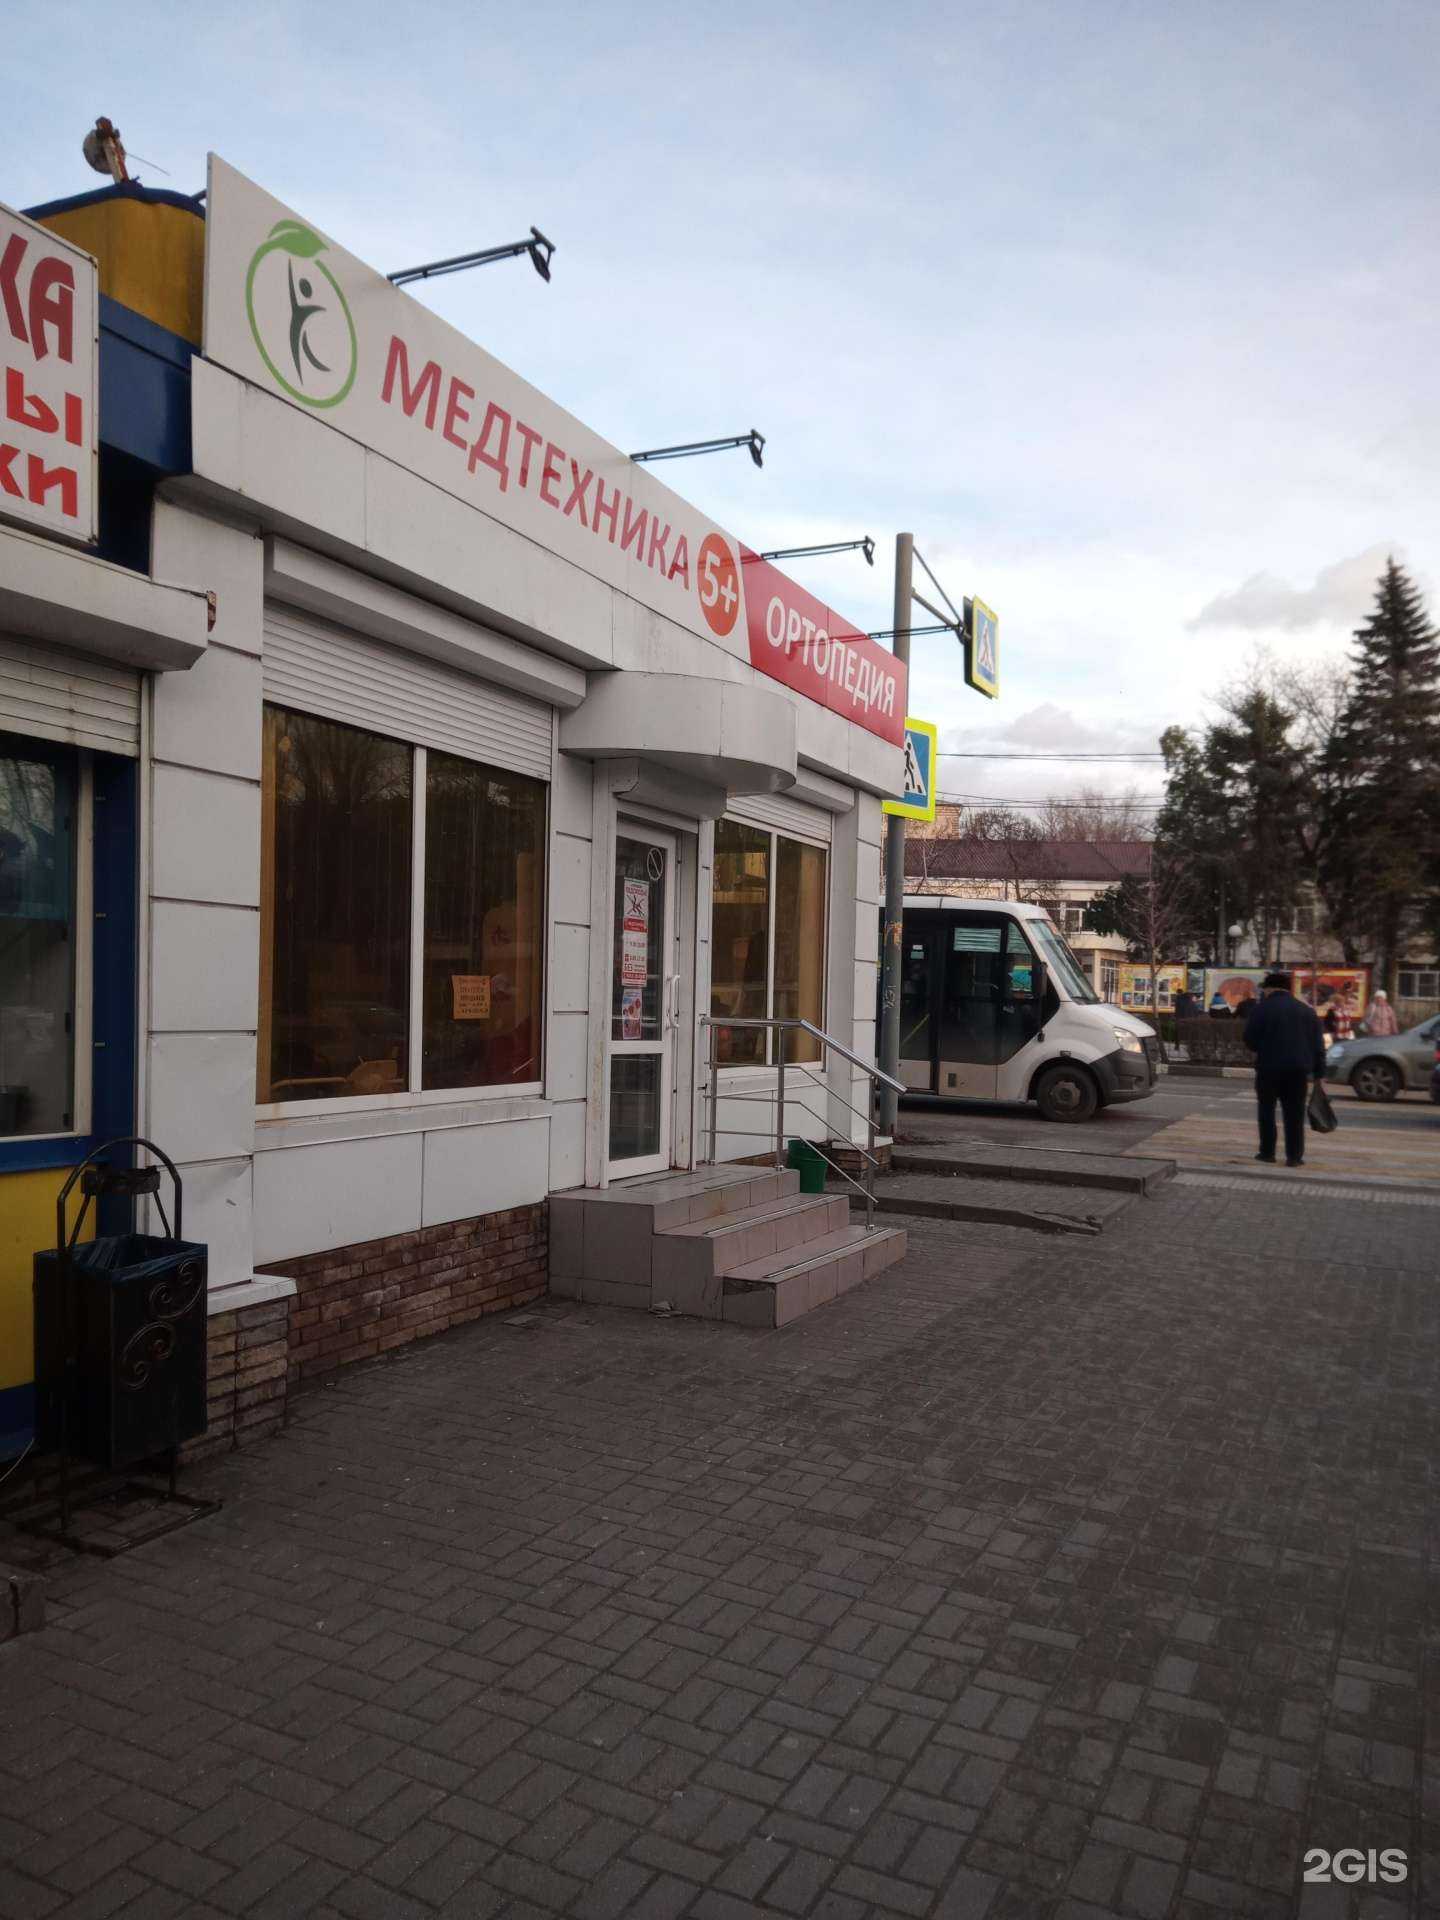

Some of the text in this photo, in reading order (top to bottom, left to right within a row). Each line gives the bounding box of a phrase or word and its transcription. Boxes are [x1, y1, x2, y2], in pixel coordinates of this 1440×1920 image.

[381, 335, 689, 591] МЕДТЕХНИКА
[701, 550, 737, 614] 5+
[766, 596, 895, 717] ОРТОПЕДИЯ
